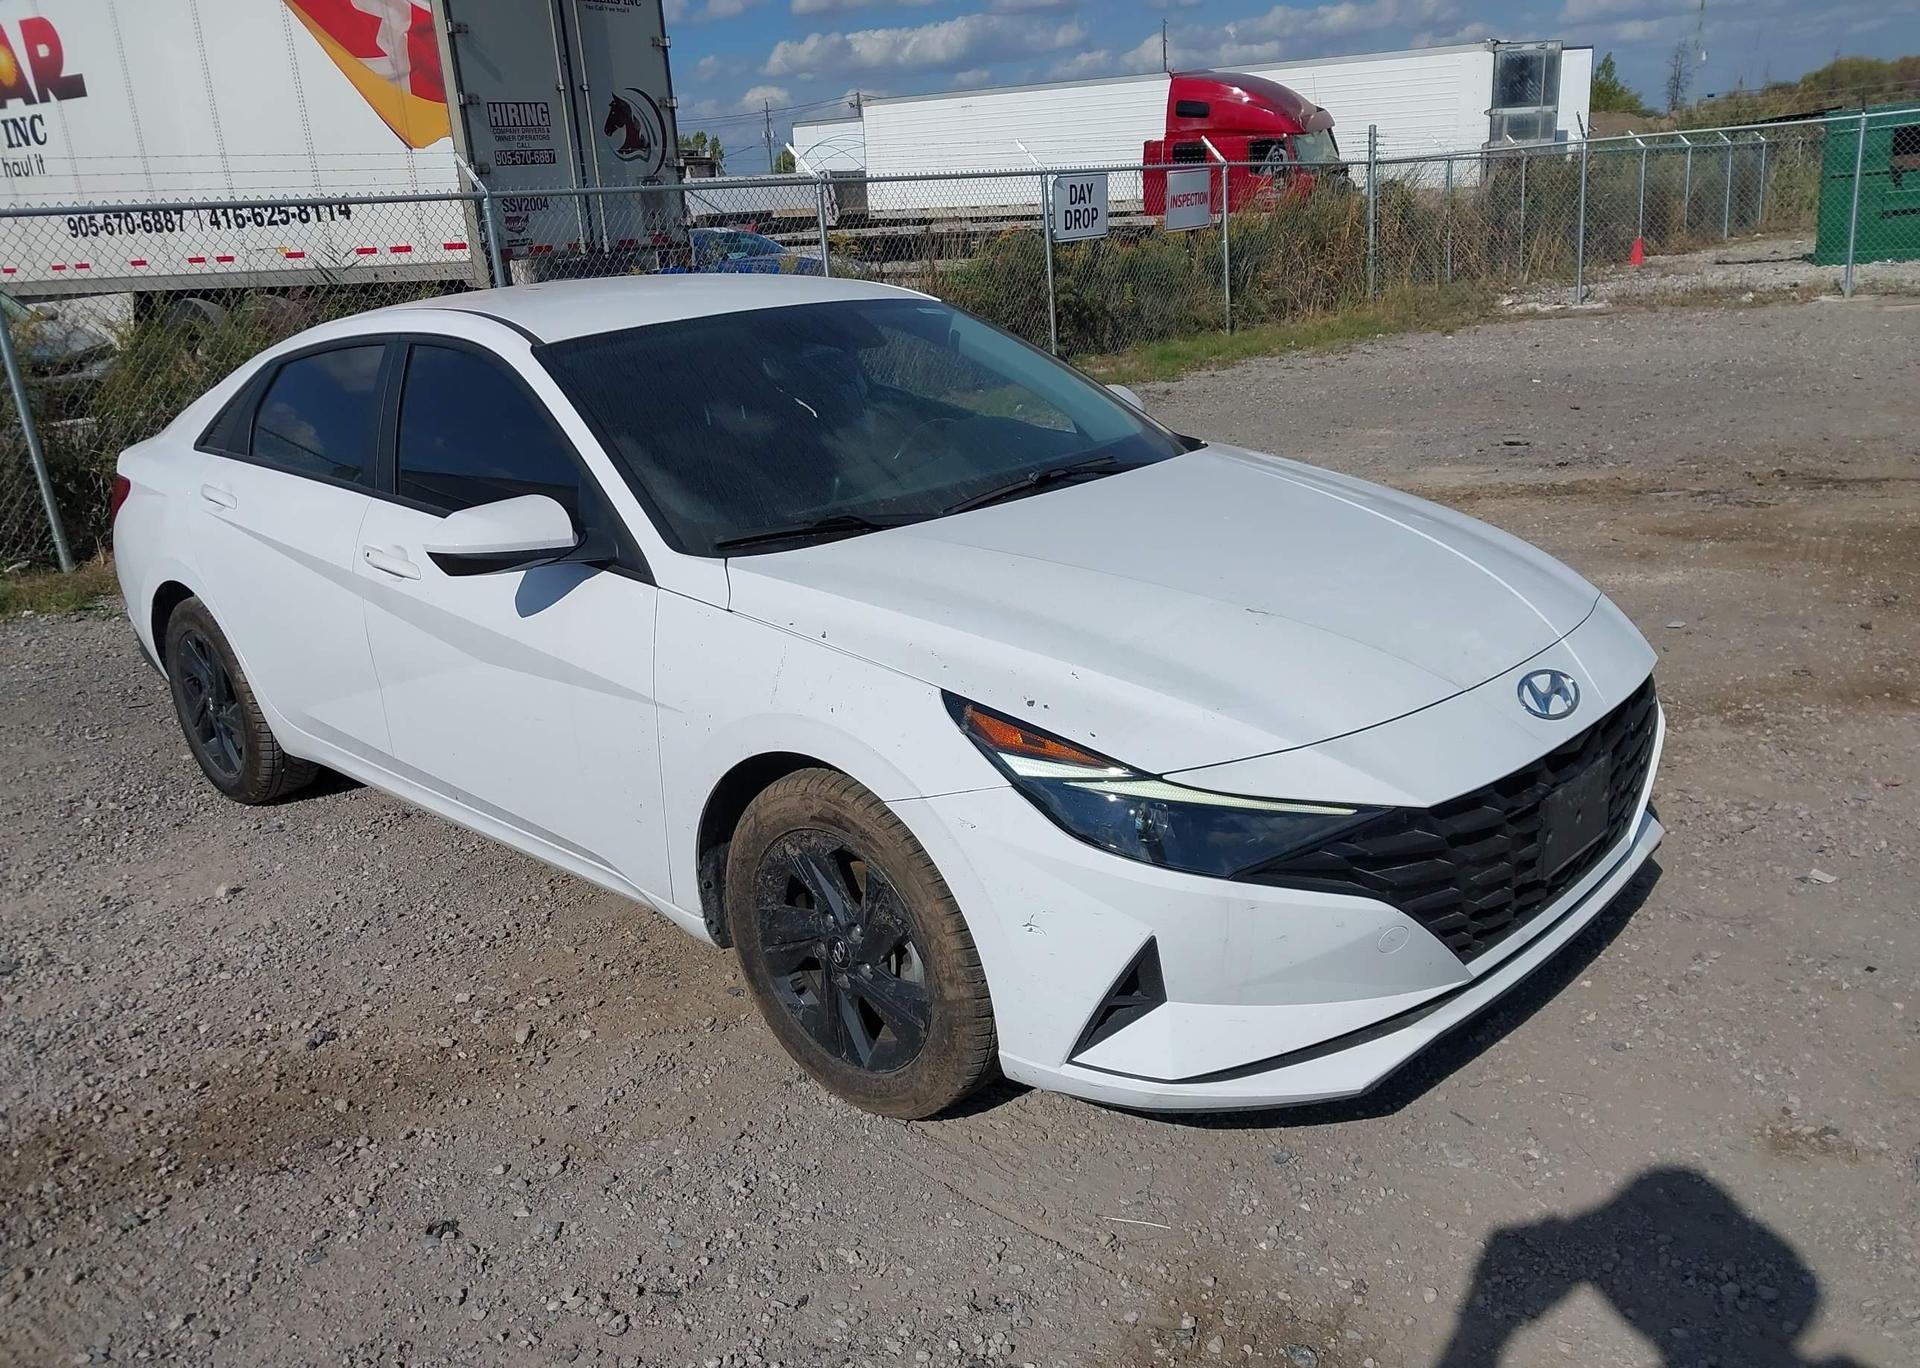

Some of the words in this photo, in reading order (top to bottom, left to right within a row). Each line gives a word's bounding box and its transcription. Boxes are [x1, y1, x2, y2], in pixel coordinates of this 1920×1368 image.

[488, 104, 550, 126] HIRING
[1, 114, 47, 148] INC
[2, 155, 34, 178] haul
[35, 153, 46, 175] it
[495, 150, 554, 165] 905-670-6887
[502, 197, 549, 212] SSV2004
[1069, 183, 1094, 205] DAY
[1170, 191, 1209, 208] INSPECTION
[67, 210, 185, 239] 905-670-6887
[209, 204, 352, 230] 416-625-8114
[1064, 207, 1099, 230] DROP
